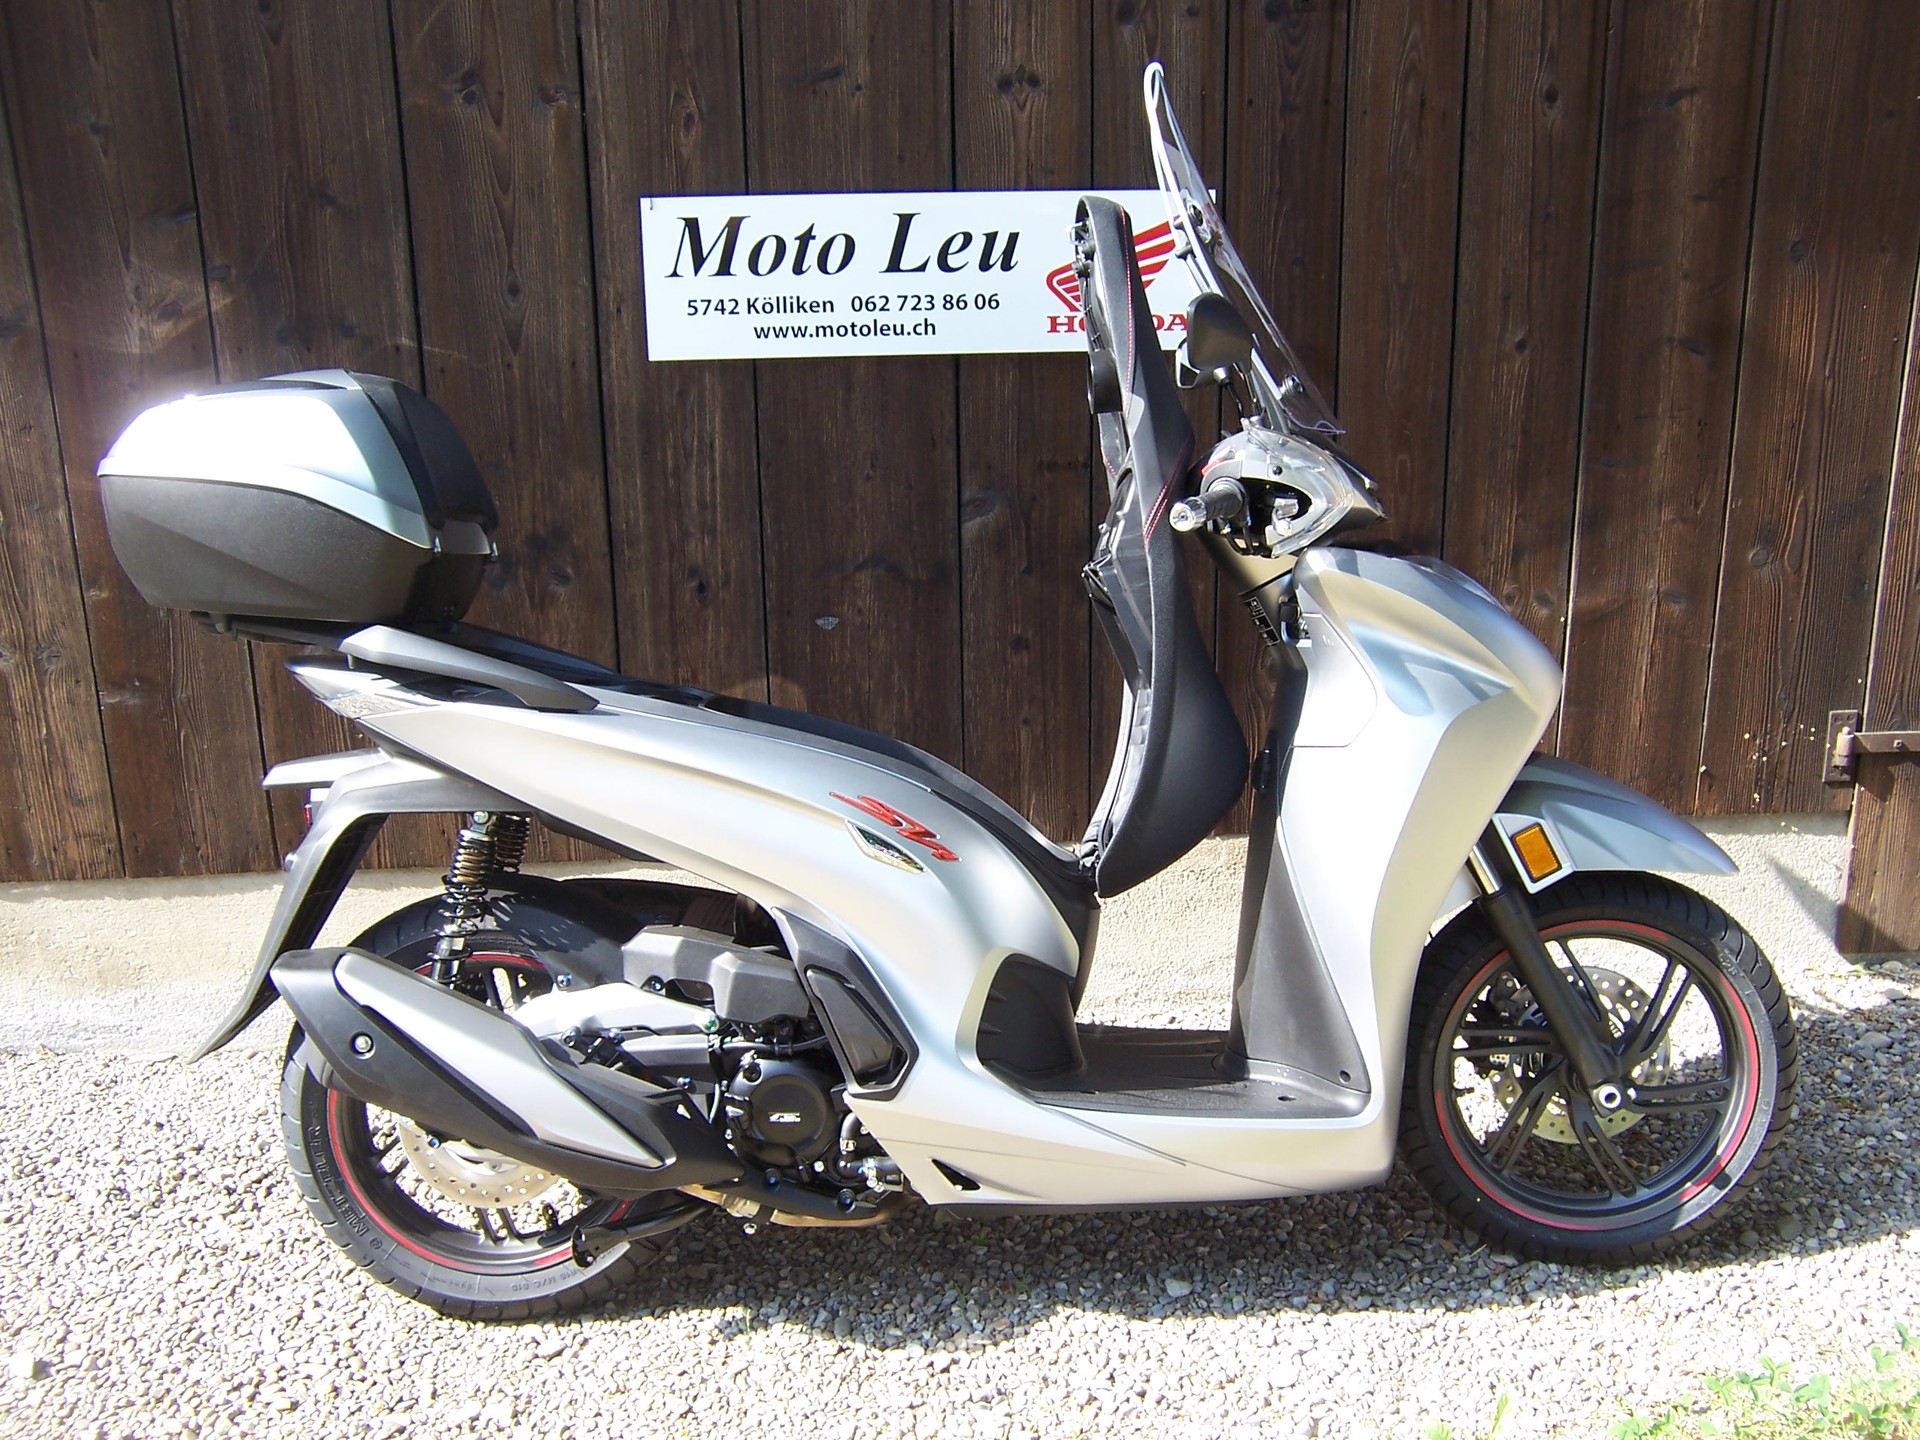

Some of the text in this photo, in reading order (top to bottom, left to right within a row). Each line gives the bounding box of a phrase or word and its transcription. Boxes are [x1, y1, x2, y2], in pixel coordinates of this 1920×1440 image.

[665, 212, 1020, 278] Moto Leu
[687, 292, 1000, 317] 5742 Kölliken 062 723 86 06
[753, 317, 936, 339] www.motoleu.ch
